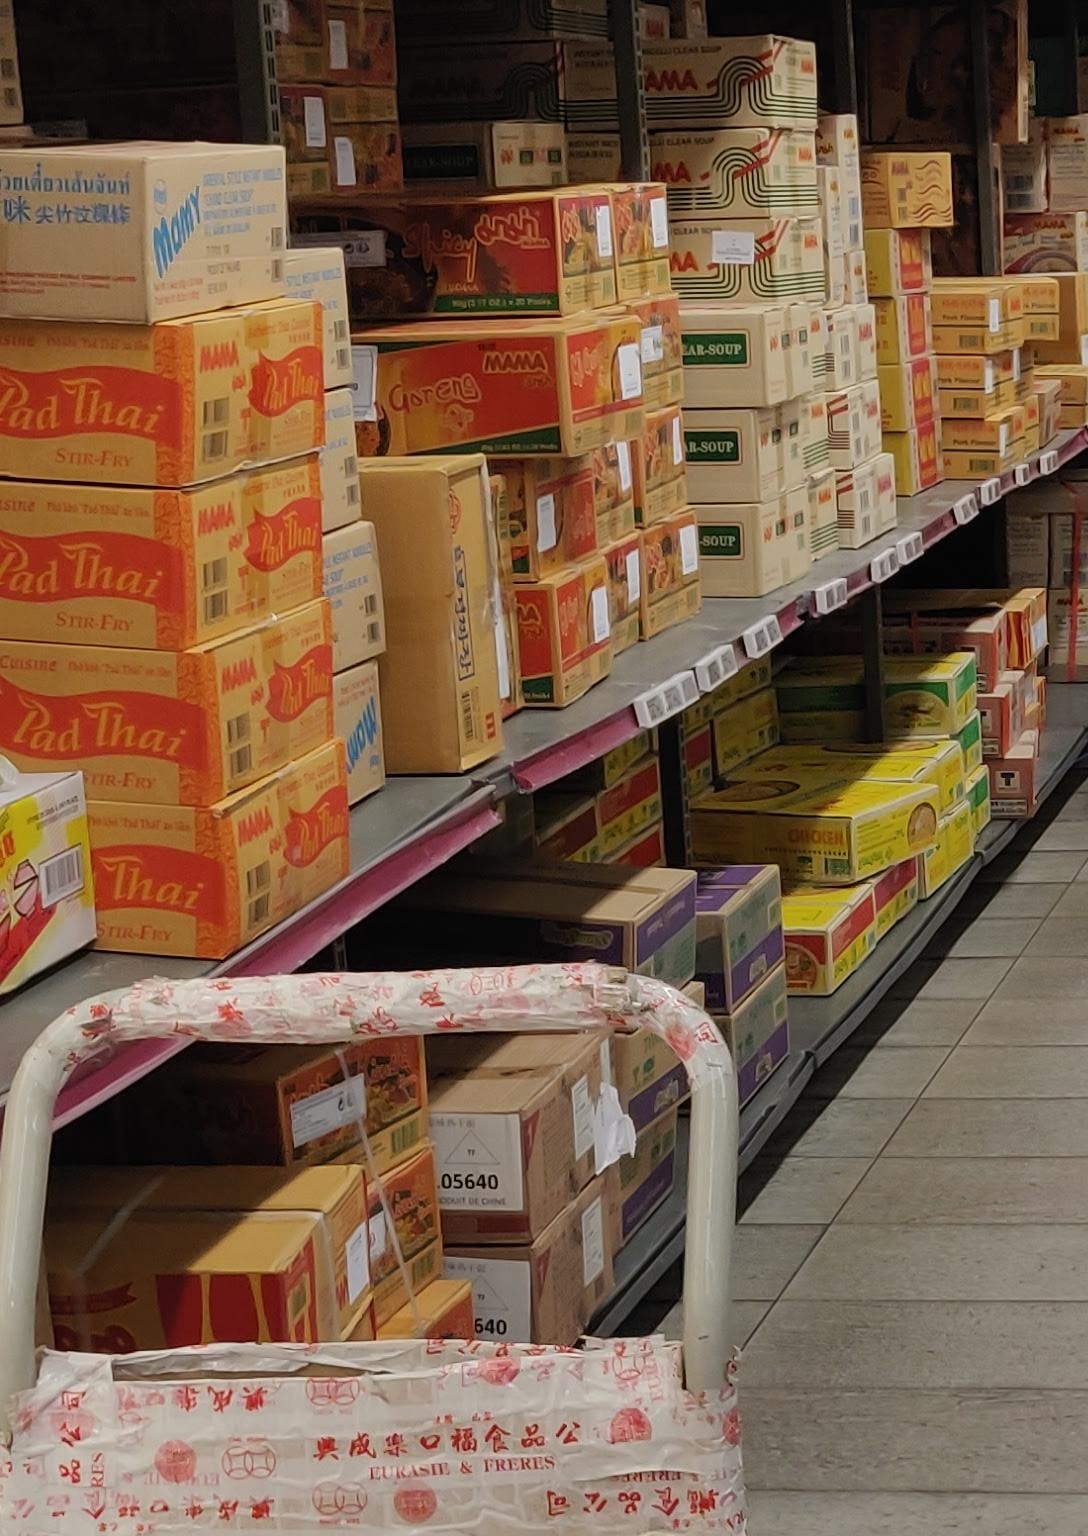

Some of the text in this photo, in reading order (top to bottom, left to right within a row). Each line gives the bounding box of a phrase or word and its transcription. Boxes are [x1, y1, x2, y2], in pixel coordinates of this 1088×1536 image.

[288, 358, 320, 397] Thai
[482, 350, 548, 374] MAMA
[60, 376, 165, 434] Thai
[388, 372, 482, 413] Goreng
[283, 511, 319, 551] Thai
[60, 541, 164, 599] Thai
[13, 694, 187, 757] Pad Thai
[99, 855, 204, 910] Thai
[368, 1454, 557, 1482] EURASIE & FRERES
